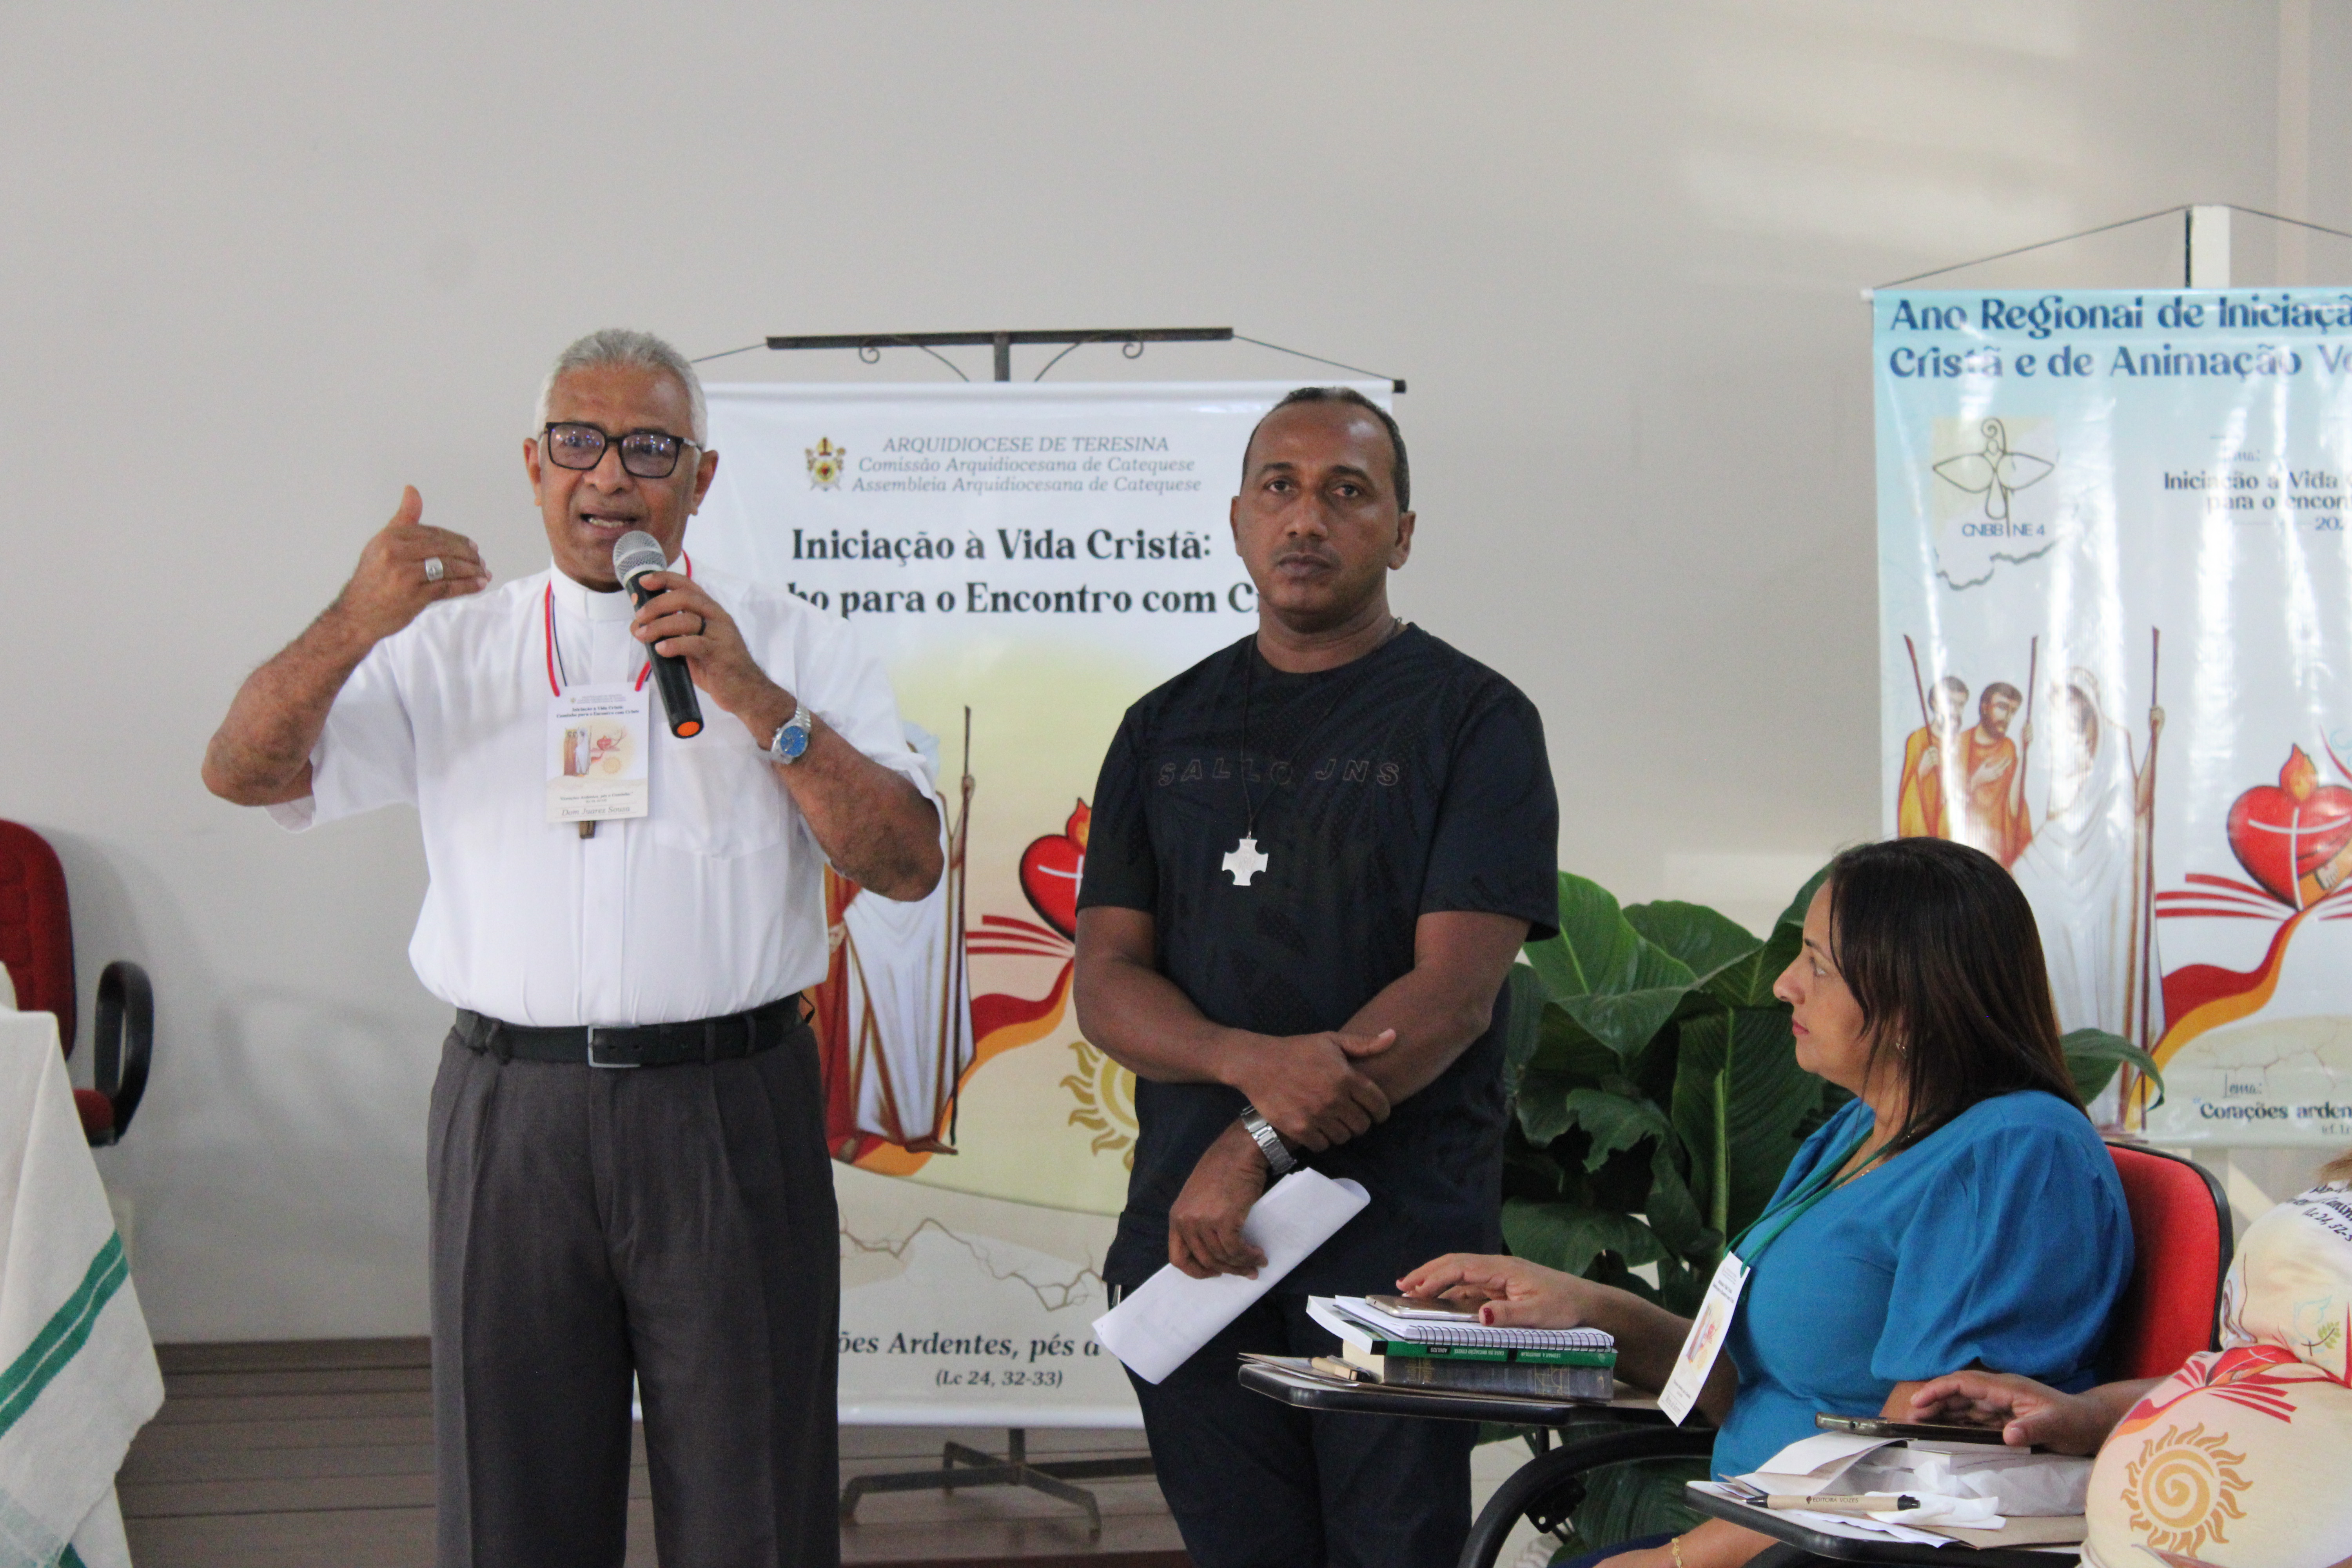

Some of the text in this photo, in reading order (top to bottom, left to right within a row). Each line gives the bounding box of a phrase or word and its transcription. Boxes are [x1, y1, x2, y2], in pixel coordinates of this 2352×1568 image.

[1890, 299, 1968, 330] Ano
[1982, 295, 2143, 339] Regional
[2158, 296, 2205, 328] de
[1890, 346, 2003, 378] Cristã
[2015, 354, 2036, 377] e
[2047, 345, 2093, 376] de
[2110, 343, 2302, 383] Animação
[883, 437, 1169, 453] ARQUIDIOCESE DE TERESINA
[859, 456, 1194, 476] Comissão Arquidiocesana de Catequese
[851, 476, 1201, 495] Assembleia Arquidiocesana de Catequese
[2290, 470, 2338, 489] Vida
[2262, 496, 2276, 510] o
[1962, 523, 2045, 536] CNBB NE 4
[792, 528, 1211, 567] Iniciação à Vida Cristã:
[840, 590, 926, 621] para
[936, 591, 956, 613] o
[965, 581, 1132, 613] Encontro
[1142, 591, 1217, 613] com
[1227, 582, 1259, 613] C
[1315, 759, 1400, 786] JNS
[887, 1331, 1018, 1360] Ardentes,
[1029, 1333, 1075, 1363] pés
[1084, 1340, 1101, 1357] a
[936, 1369, 1063, 1389] (Lc 24, 32-33)
